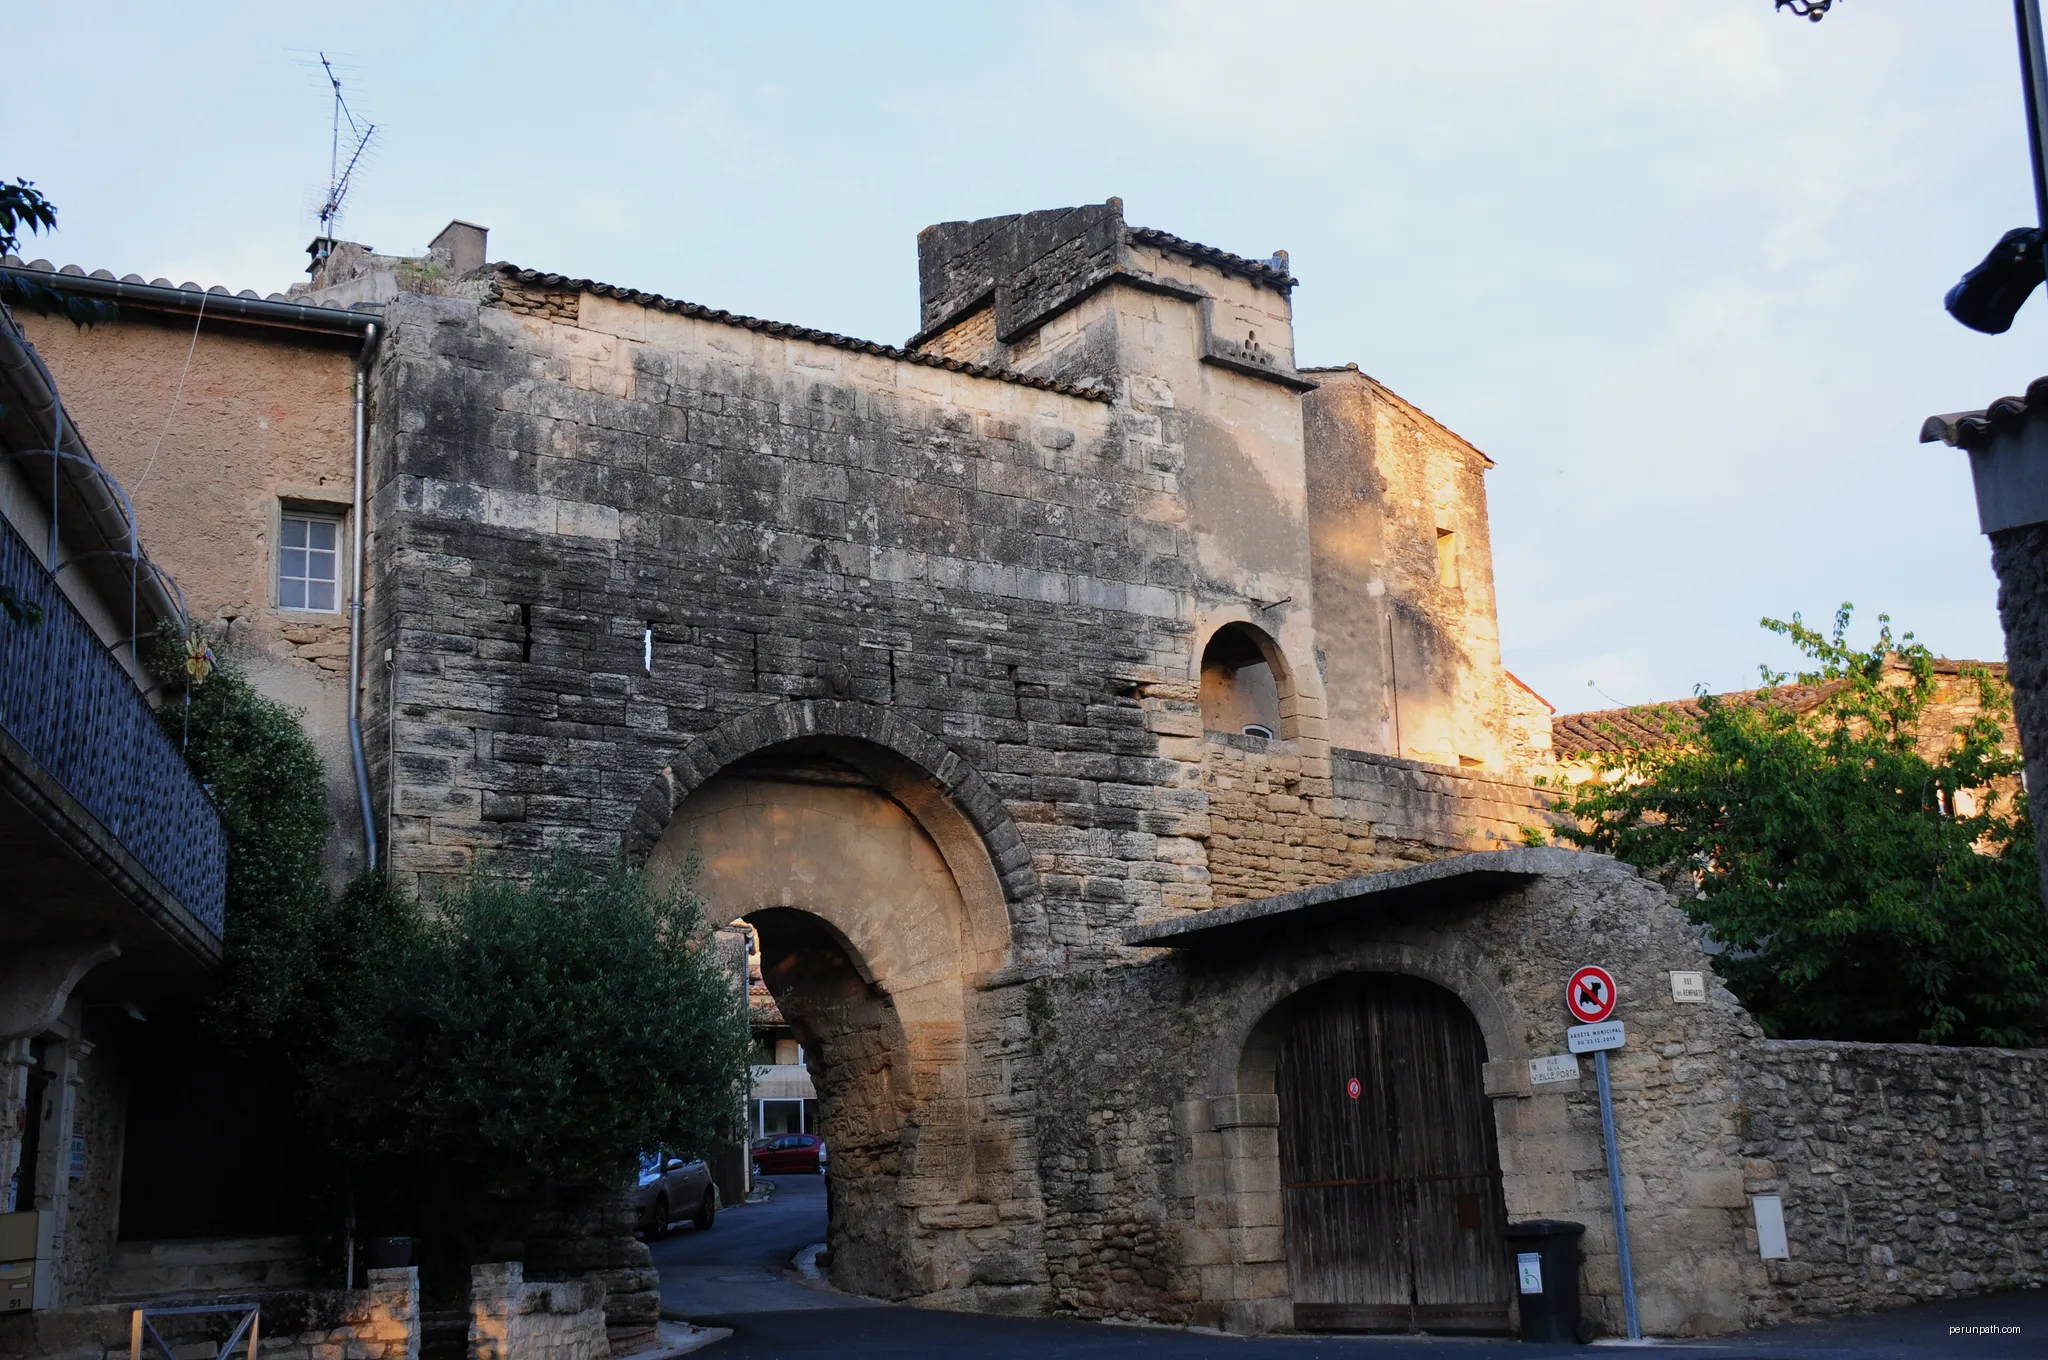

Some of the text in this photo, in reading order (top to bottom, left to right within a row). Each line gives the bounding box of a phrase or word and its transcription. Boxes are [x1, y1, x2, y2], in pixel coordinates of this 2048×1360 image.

[1592, 1027, 1621, 1036] MUNICIPAL
[1556, 1069, 1577, 1078] PORTE
[9, 1298, 21, 1308] 51
